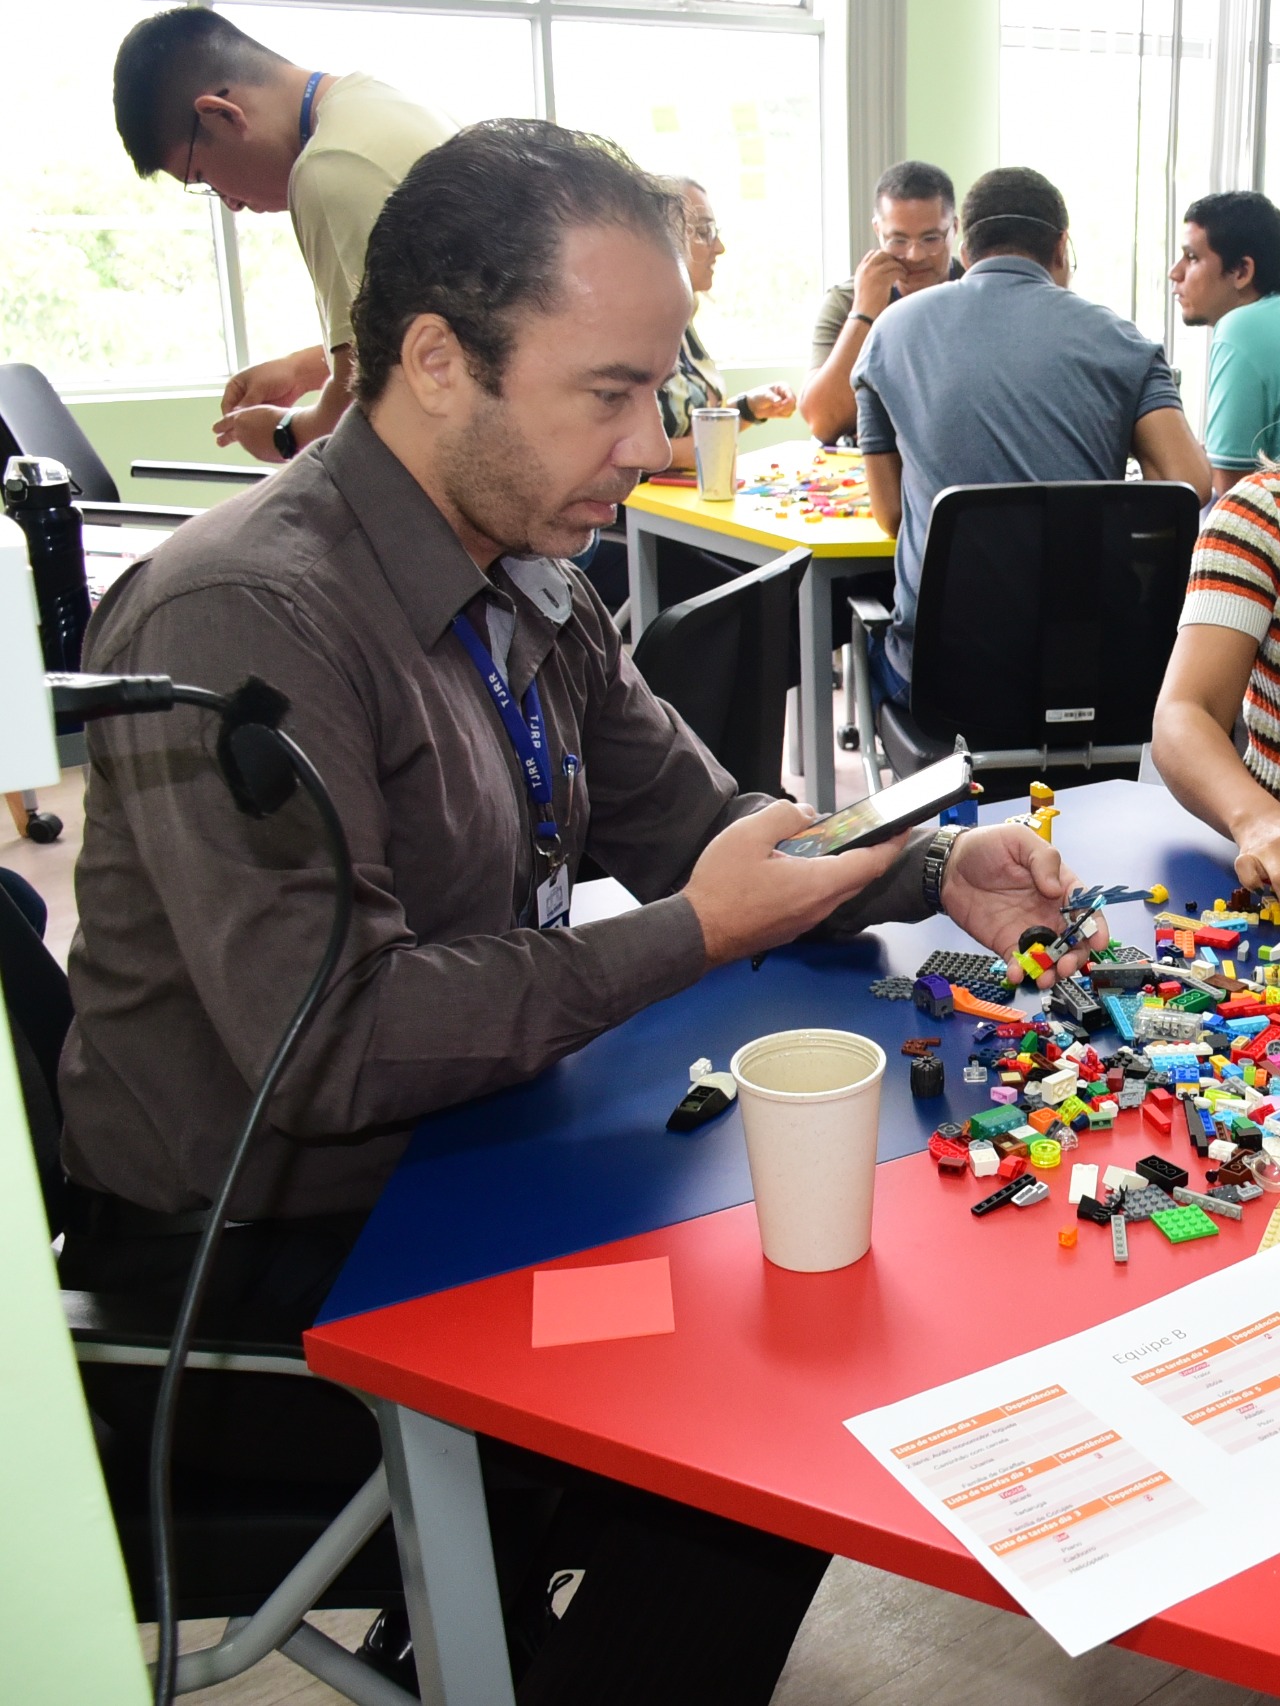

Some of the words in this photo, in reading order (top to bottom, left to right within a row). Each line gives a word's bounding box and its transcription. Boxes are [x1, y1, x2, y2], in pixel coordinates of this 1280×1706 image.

[488, 672, 509, 708] TJRR
[525, 757, 542, 789] TJRR
[1112, 1336, 1173, 1364] Equipe
[1171, 1328, 1187, 1340] B
[1136, 1371, 1156, 1382] Lista
[1165, 1356, 1192, 1370] tarefas
[1191, 1350, 1204, 1360] dia
[1232, 1314, 1280, 1342] Dependências
[895, 1443, 916, 1455] Lista
[916, 1438, 928, 1446] de
[928, 1427, 957, 1442] tarefas
[957, 1421, 971, 1431] dia
[970, 1418, 978, 1426] 1
[1005, 1387, 1060, 1412] Dependências
[1187, 1410, 1207, 1421] Lista
[1206, 1405, 1217, 1413] de
[1215, 1395, 1242, 1409] tarefas
[1241, 1390, 1254, 1398] dia
[946, 1494, 968, 1505] Lista
[968, 1488, 981, 1497] de
[980, 1477, 1010, 1492] tarefas
[1010, 1471, 1024, 1480] dia
[1058, 1433, 1115, 1460] Dependências
[994, 1539, 1016, 1552] Lista
[1016, 1534, 1028, 1543] de
[1027, 1521, 1059, 1537] tarefas
[1058, 1514, 1073, 1524] dia
[1107, 1473, 1164, 1502] Dependências
